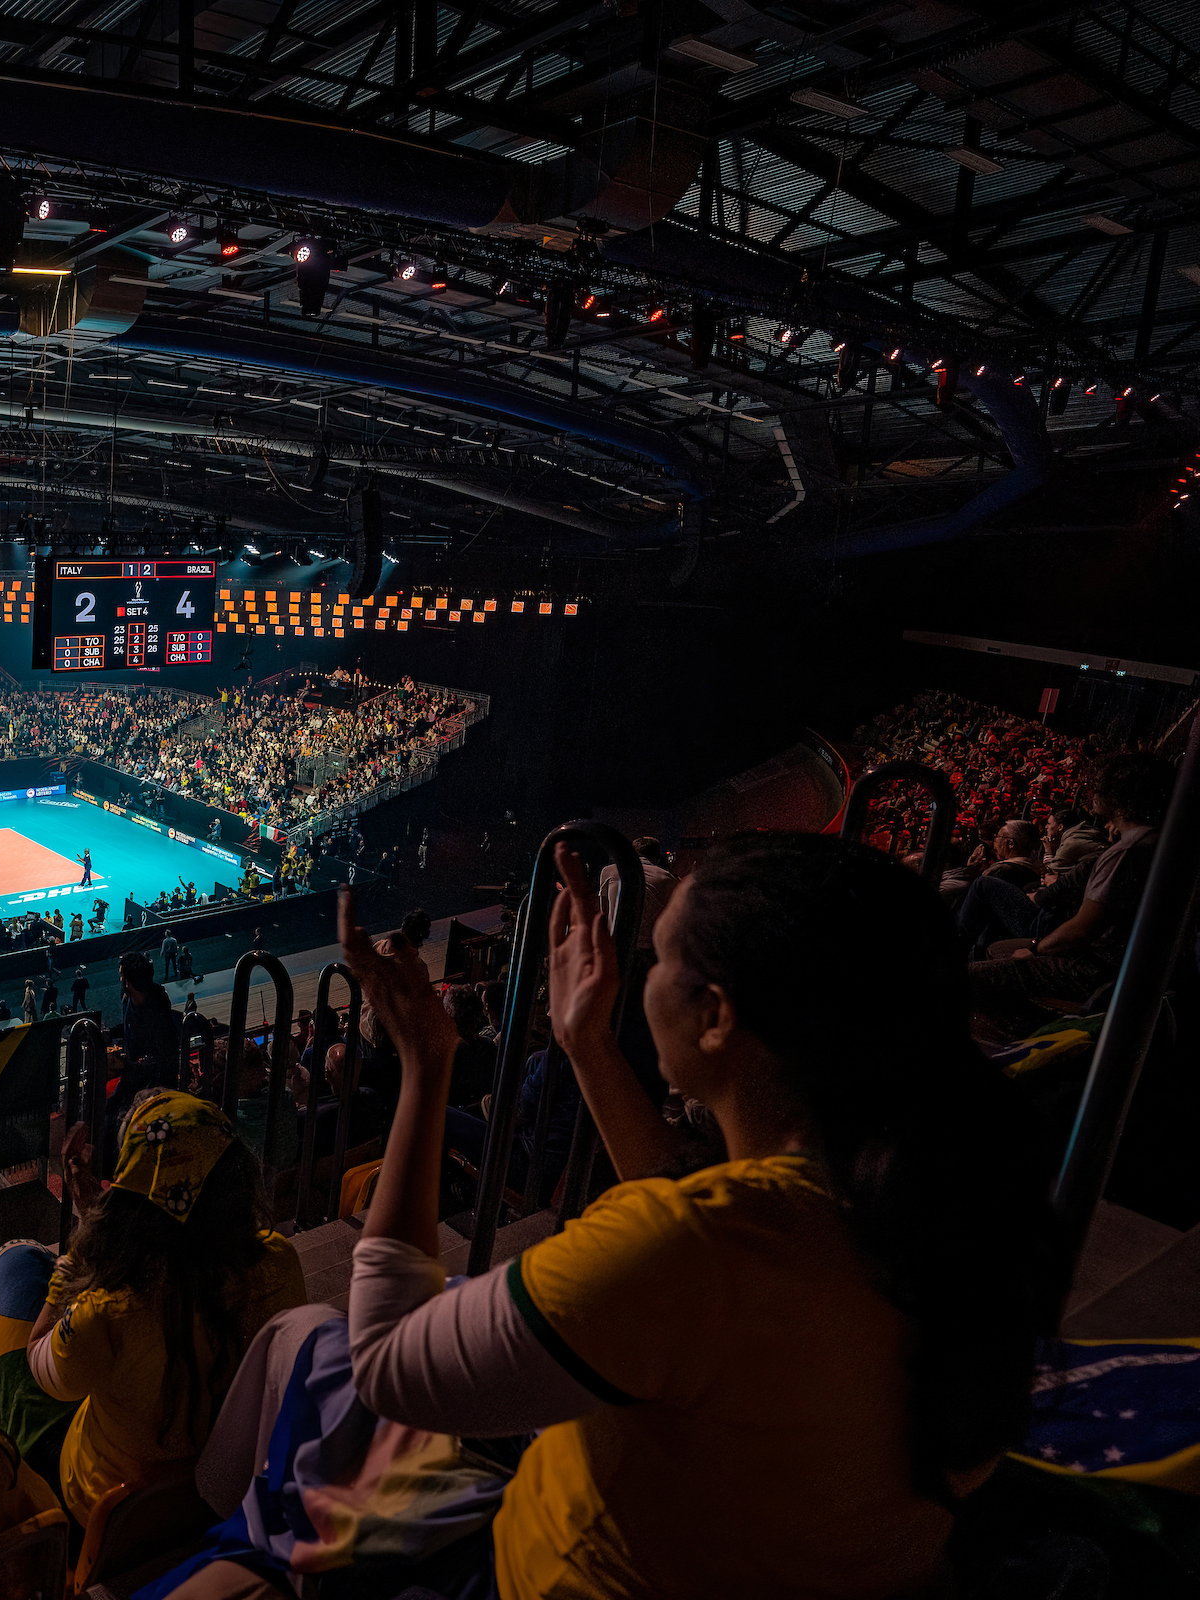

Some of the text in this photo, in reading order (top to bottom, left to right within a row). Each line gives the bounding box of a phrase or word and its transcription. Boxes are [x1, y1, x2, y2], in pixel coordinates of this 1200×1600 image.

[60, 566, 82, 575] ITALY
[129, 565, 134, 575] 1
[143, 565, 151, 575] 2
[187, 566, 212, 574] BRAZIL
[75, 592, 96, 623] 2
[176, 590, 195, 619] 4
[126, 607, 149, 616] SET 4
[114, 626, 125, 634] 23
[148, 625, 159, 633] 25
[66, 637, 100, 647] 1 T/O
[114, 635, 159, 644] 25 2 22
[172, 633, 203, 642] T/O 0
[113, 645, 158, 655] 24 3 26
[171, 643, 203, 652] SUB 0
[64, 648, 100, 657] 0 SUB
[133, 656, 139, 664] 4
[170, 653, 186, 662] CHA
[64, 659, 101, 668] 0 CHA
[18, 885, 94, 903] DHL
